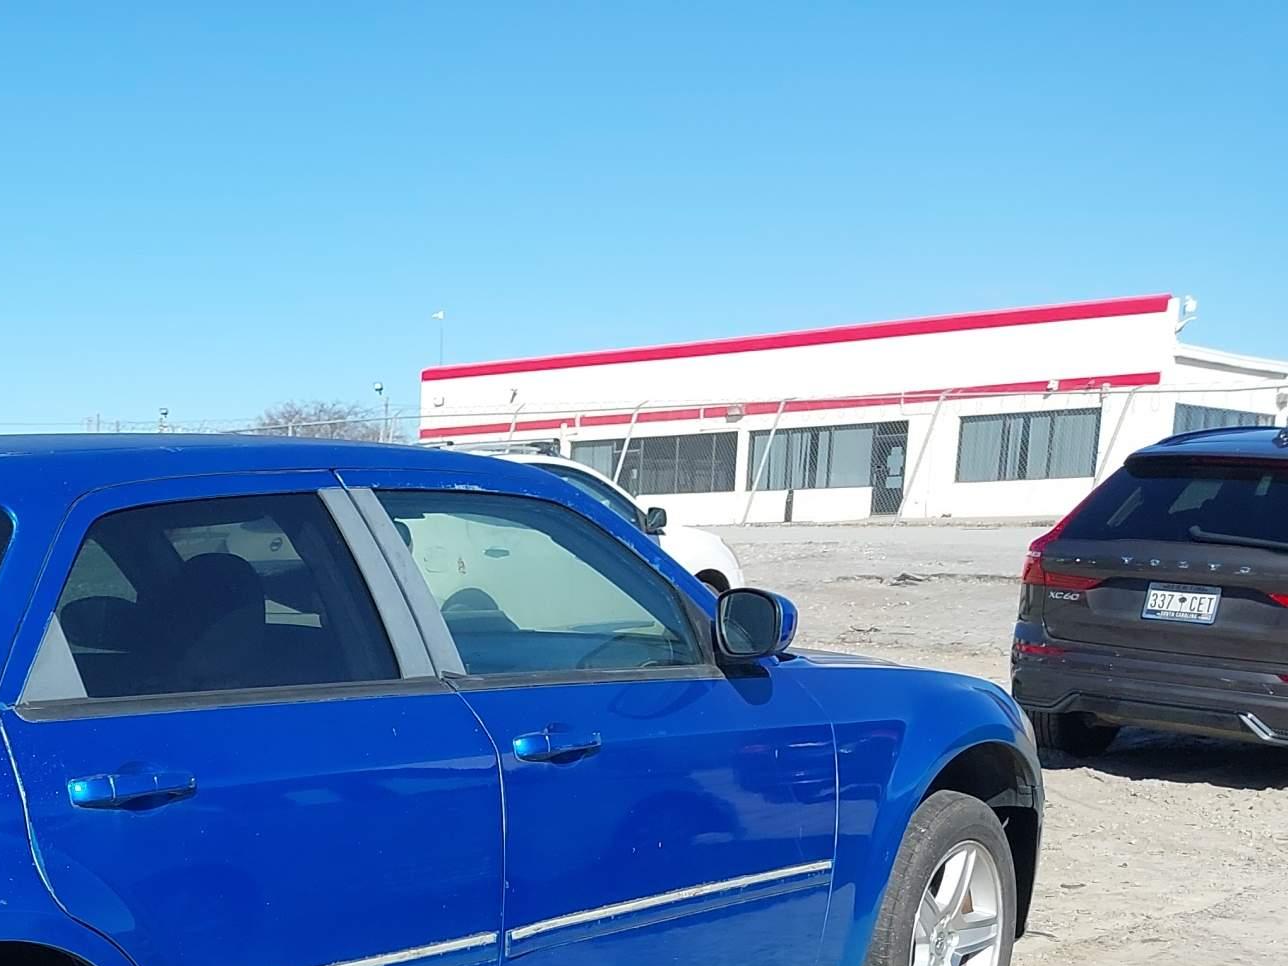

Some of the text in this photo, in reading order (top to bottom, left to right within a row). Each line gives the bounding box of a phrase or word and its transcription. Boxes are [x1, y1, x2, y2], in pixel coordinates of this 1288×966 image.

[1048, 591, 1080, 601] XC60
[1150, 593, 1215, 613] 337 CET
